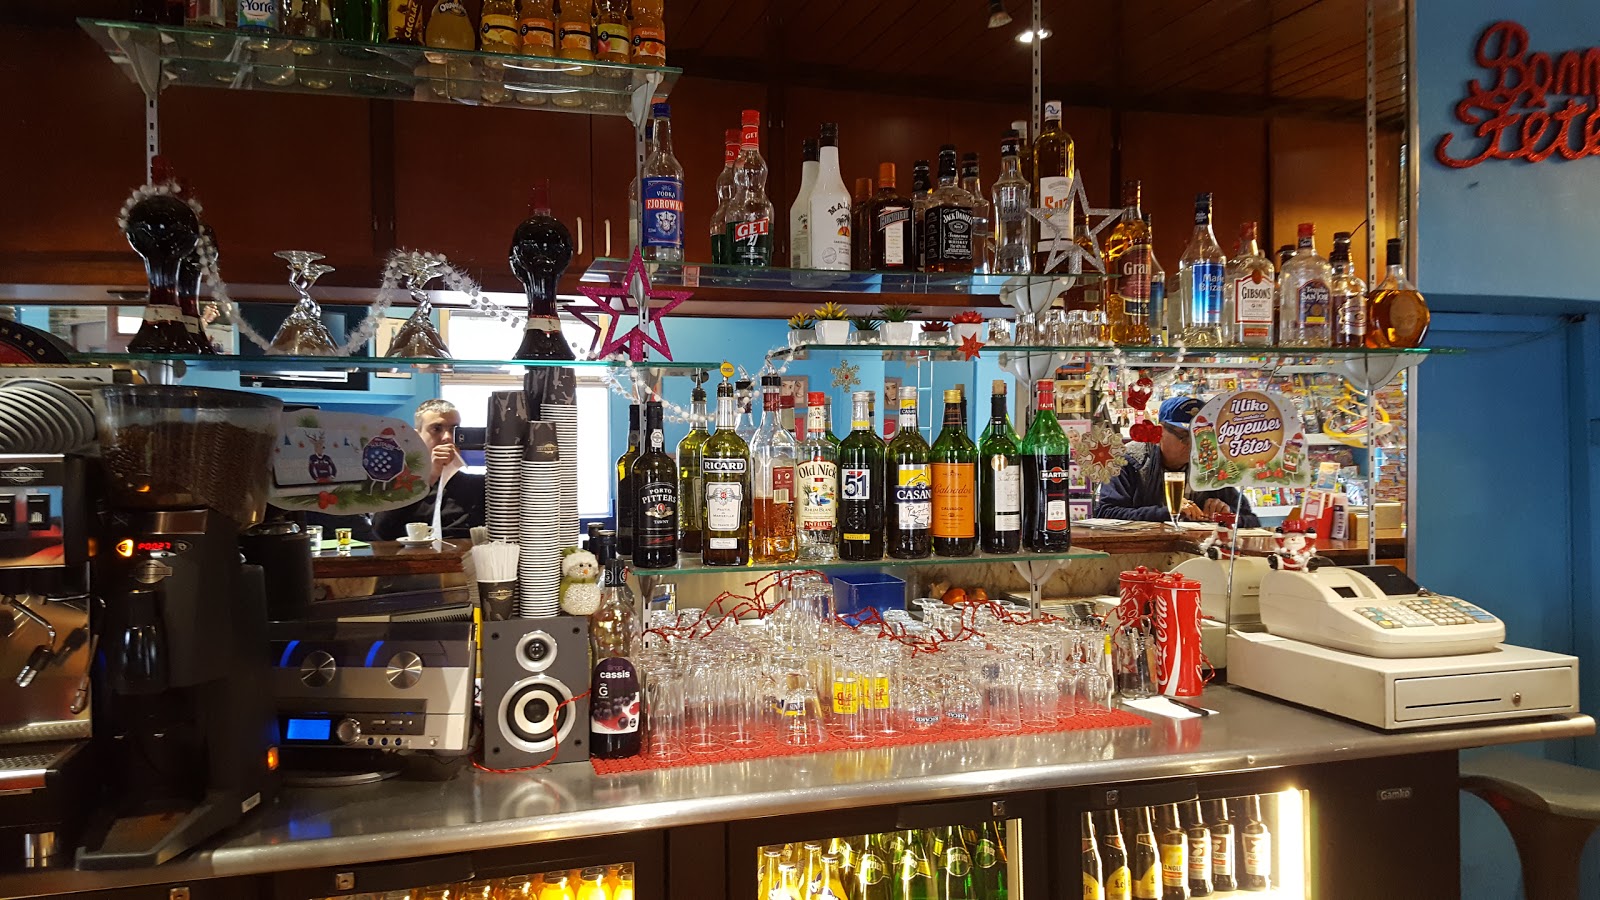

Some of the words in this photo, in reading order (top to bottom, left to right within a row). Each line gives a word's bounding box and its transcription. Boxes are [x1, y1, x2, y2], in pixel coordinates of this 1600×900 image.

[647, 199, 684, 211] FJOROWKA
[737, 220, 766, 237] GET
[747, 234, 759, 246] 27
[1230, 399, 1269, 414] illiko
[1218, 418, 1281, 443] Joyeuses
[1230, 438, 1271, 457] Fêtes
[704, 462, 743, 470] RICARD
[798, 464, 813, 479] Old
[817, 463, 837, 479] Nick
[844, 474, 867, 497] 51
[641, 494, 677, 504] PITTERS
[599, 669, 630, 679] cassis
[598, 686, 608, 696] G
[1380, 789, 1411, 800] Gamko
